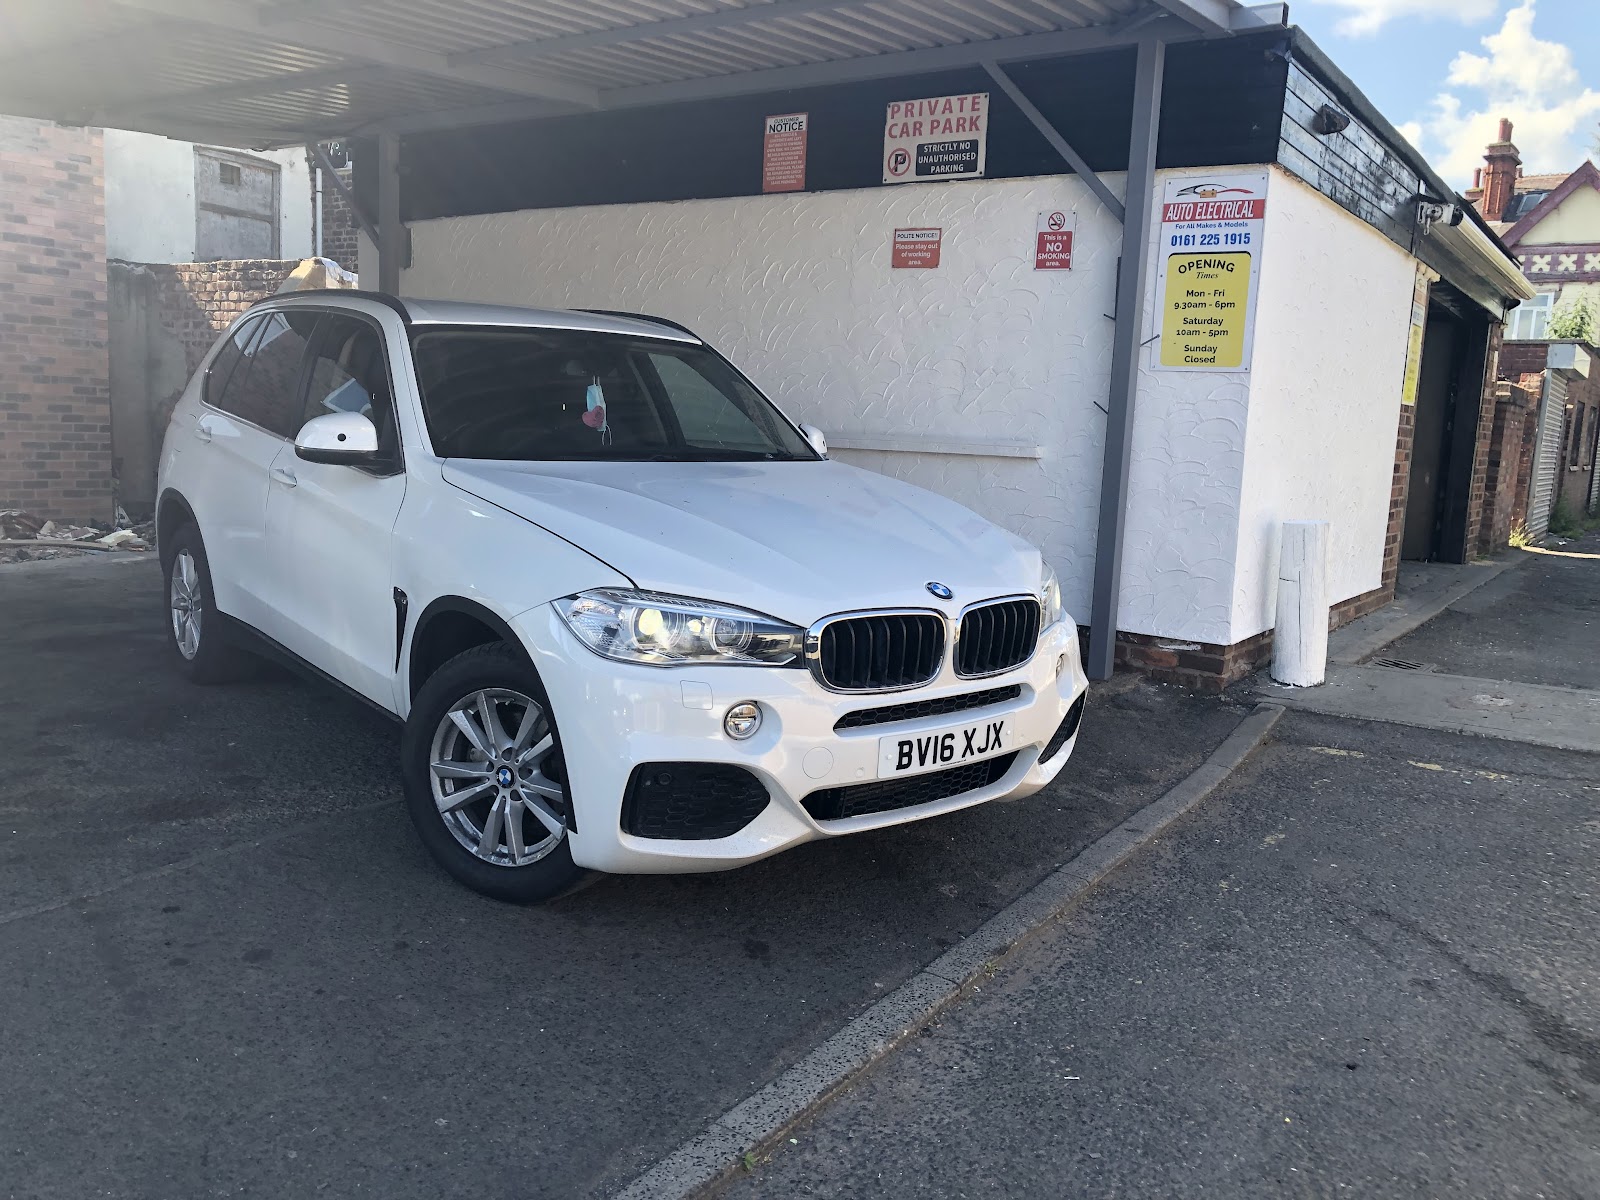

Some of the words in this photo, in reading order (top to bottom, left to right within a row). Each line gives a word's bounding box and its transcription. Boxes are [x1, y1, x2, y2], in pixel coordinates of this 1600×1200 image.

[890, 96, 980, 119] PRIVATE
[769, 121, 804, 133] NOTICE
[888, 120, 922, 138] CAR
[930, 115, 980, 135] PARK
[924, 143, 958, 152] STRICTLY
[959, 142, 970, 150] NO
[918, 152, 976, 164] UNAUTHORISED
[930, 164, 964, 173] PARKING
[1166, 203, 1194, 220] AUTO
[1195, 200, 1254, 219] ELECTRICAL
[1171, 234, 1196, 246] 0161
[1200, 234, 1220, 245] 225
[1224, 233, 1250, 244] 1915
[1046, 242, 1063, 252] NO
[1178, 259, 1235, 274] OPENING
[1215, 301, 1236, 309] 6pm
[1183, 317, 1224, 326] Saturday
[1184, 344, 1218, 354] Sunday
[896, 733, 955, 770] BV16
[962, 721, 1004, 758] XJX
